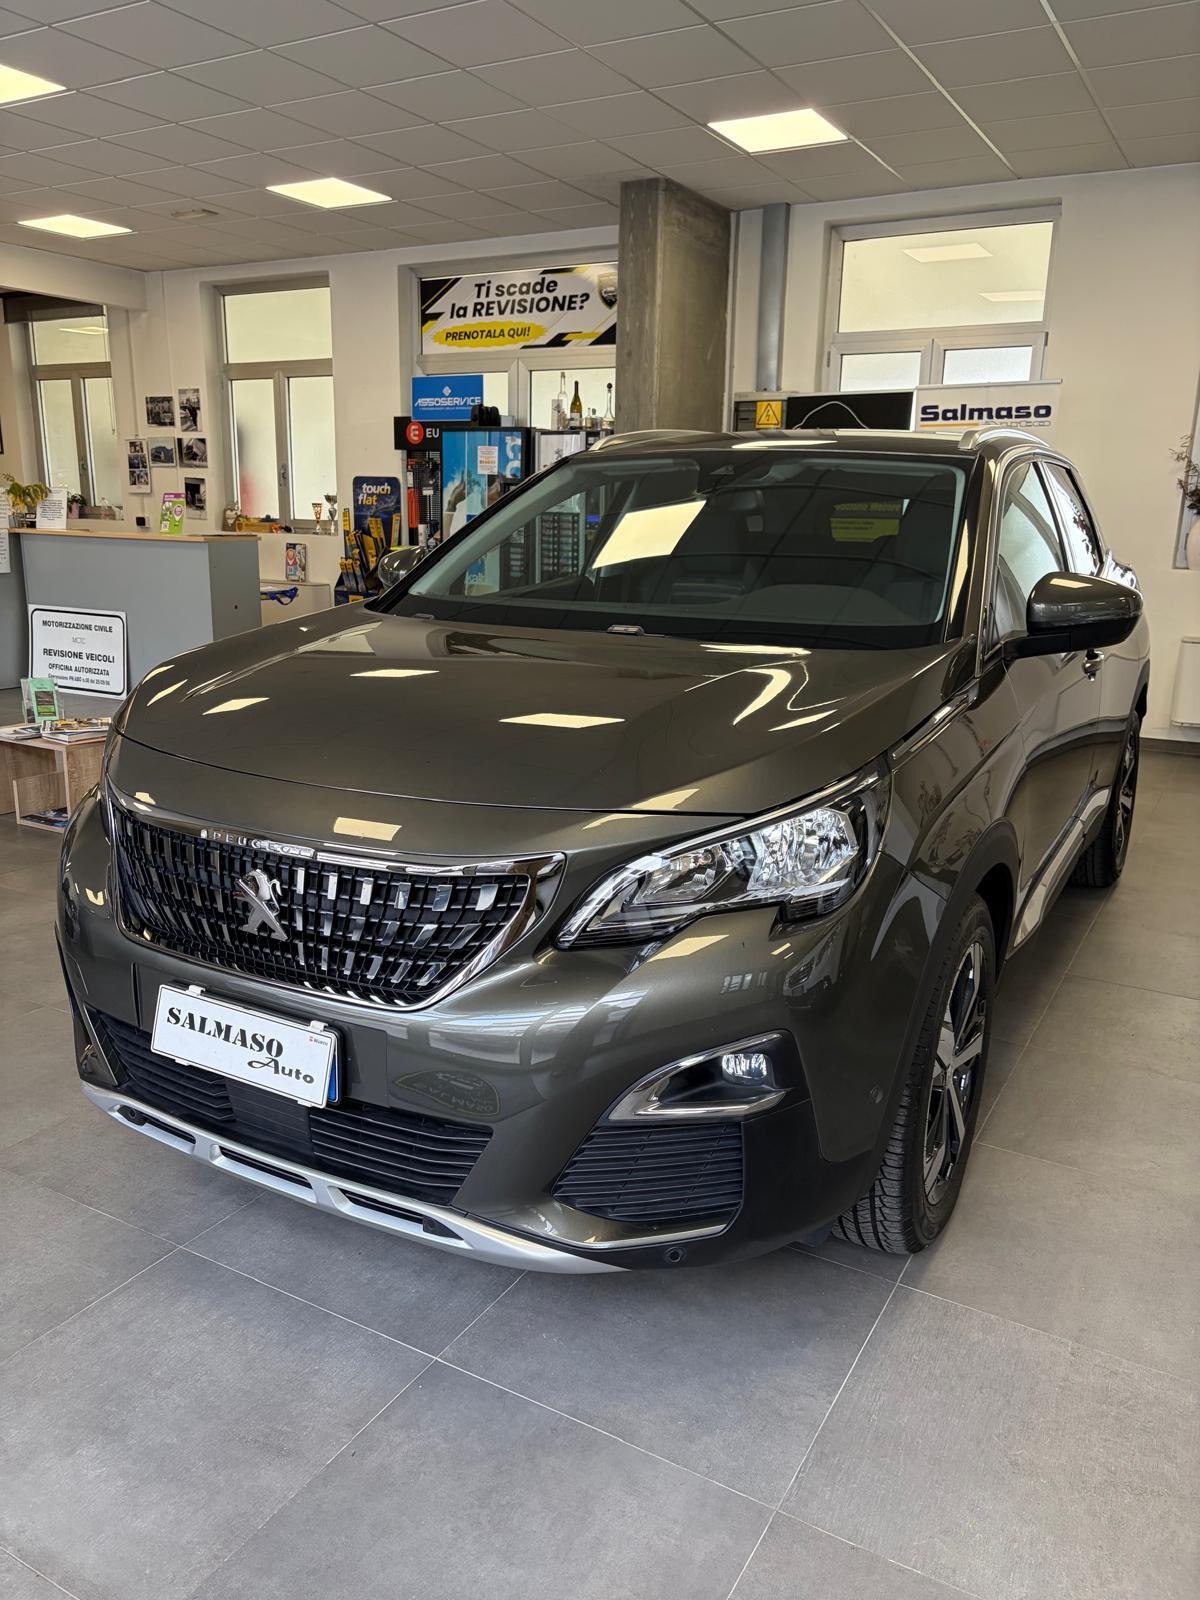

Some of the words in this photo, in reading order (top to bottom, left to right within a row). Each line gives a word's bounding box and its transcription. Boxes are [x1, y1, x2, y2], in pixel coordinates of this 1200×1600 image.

[475, 280, 491, 298] Ti
[495, 277, 558, 297] scade
[450, 304, 468, 319] la
[473, 293, 590, 318] REVISIONE?
[445, 328, 505, 341] PRENOTALA
[507, 326, 531, 339] QUI!
[920, 404, 1052, 422] Salmaso
[362, 482, 391, 495] touch
[358, 494, 378, 506] flat
[42, 620, 93, 631] MOTORIZZAZIONE
[93, 624, 113, 633] CIVILE
[43, 648, 83, 660] REVISIONE
[85, 652, 115, 663] VEICOLI
[48, 663, 73, 671] OFFICINA
[74, 667, 110, 676] AUTORIZZATA
[167, 1006, 284, 1058] SALMASO
[247, 1056, 314, 1084] Auto
